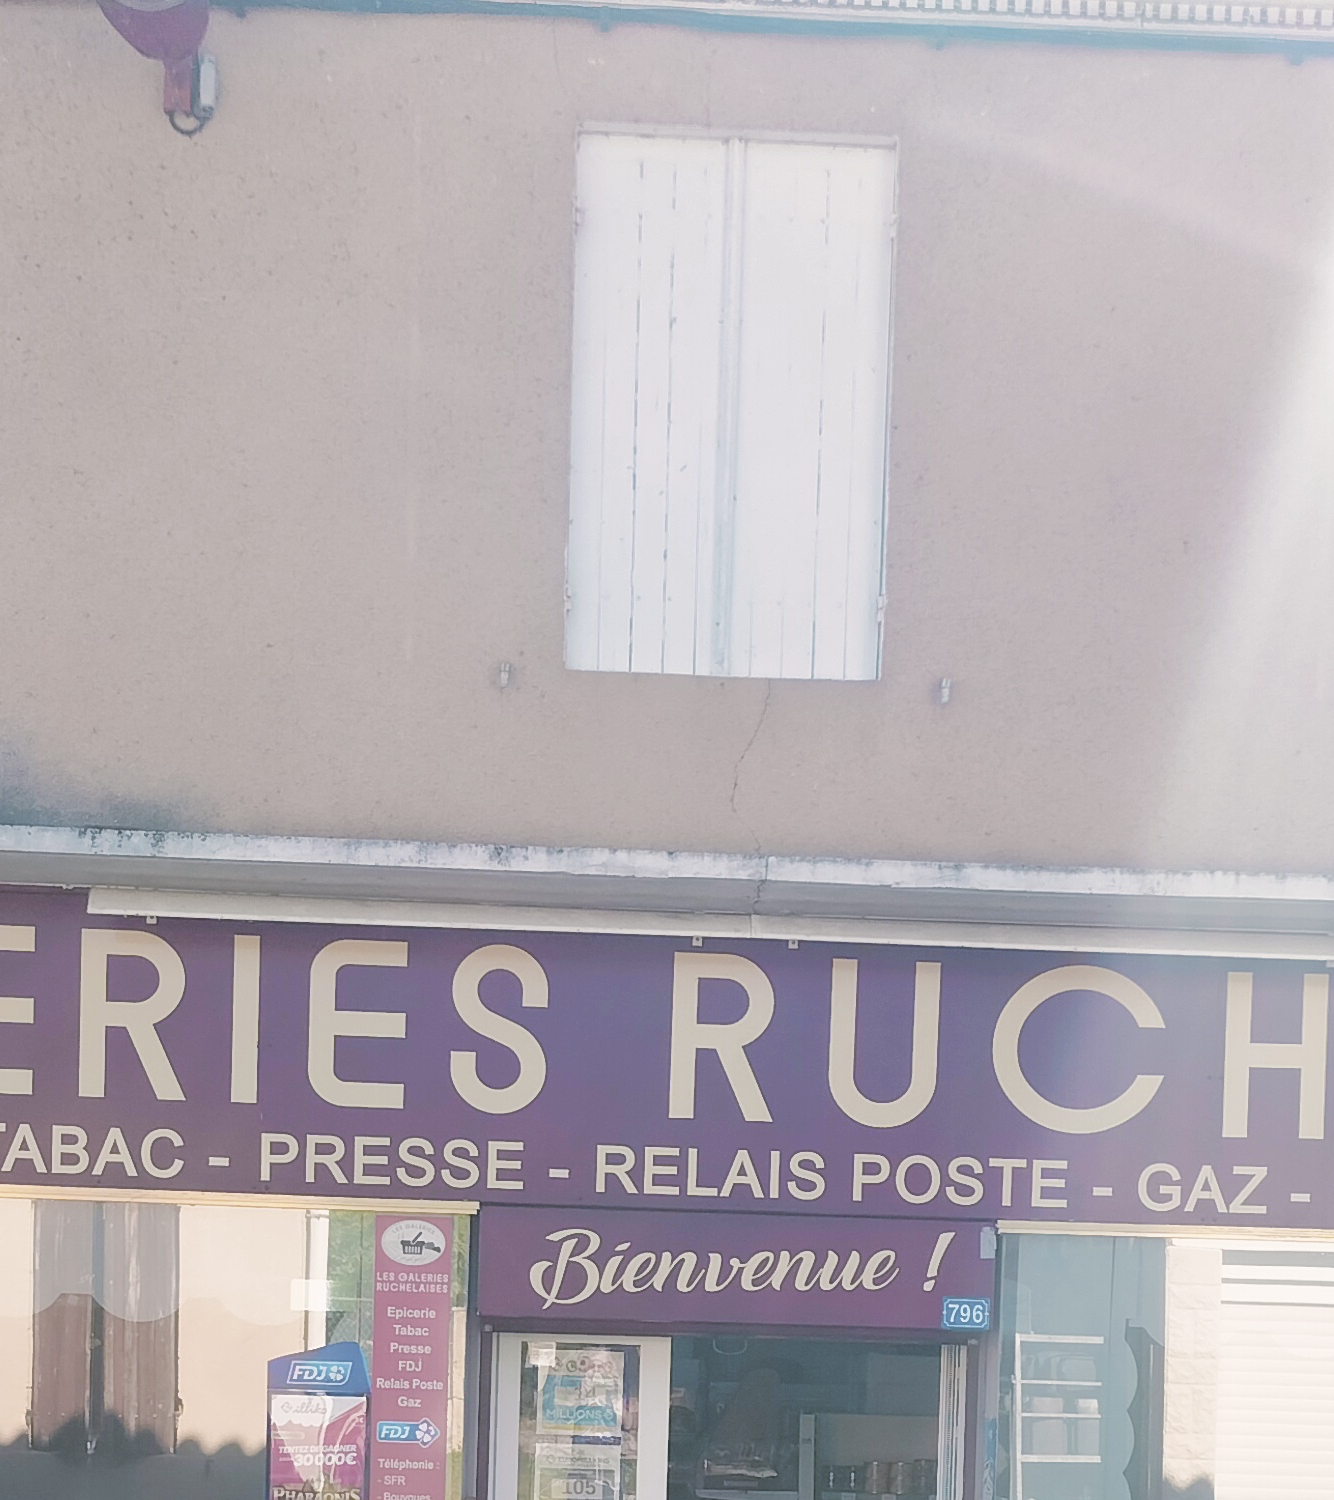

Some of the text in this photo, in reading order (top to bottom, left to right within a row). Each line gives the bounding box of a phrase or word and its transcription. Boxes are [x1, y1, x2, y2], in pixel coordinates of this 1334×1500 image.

[260, 1132, 525, 1190] PRESSE
[594, 1143, 827, 1201] RELAIS
[852, 1153, 1068, 1209] POSTE
[1137, 1162, 1268, 1215] GAZ
[528, 1227, 957, 1310] Bienvenue !
[376, 1272, 449, 1283] LES GALERIES
[376, 1282, 449, 1294] RUCHELAISES
[387, 1306, 436, 1320] Epicerie
[948, 1303, 984, 1323] 796
[392, 1324, 430, 1336] Tabac
[390, 1342, 432, 1354] Presse
[398, 1359, 422, 1372] FDJ
[292, 1365, 327, 1380] FDJ
[376, 1378, 444, 1390] Relais Poste
[397, 1396, 422, 1408] Gaz
[546, 1409, 601, 1419] MILLIONS
[380, 1425, 410, 1439] FDJ
[278, 1446, 310, 1454] TENTEZ
[322, 1444, 357, 1453] GAGNER
[377, 1459, 434, 1471] Téléphonie
[383, 1475, 406, 1485] SFR
[561, 1480, 596, 1495] 105
